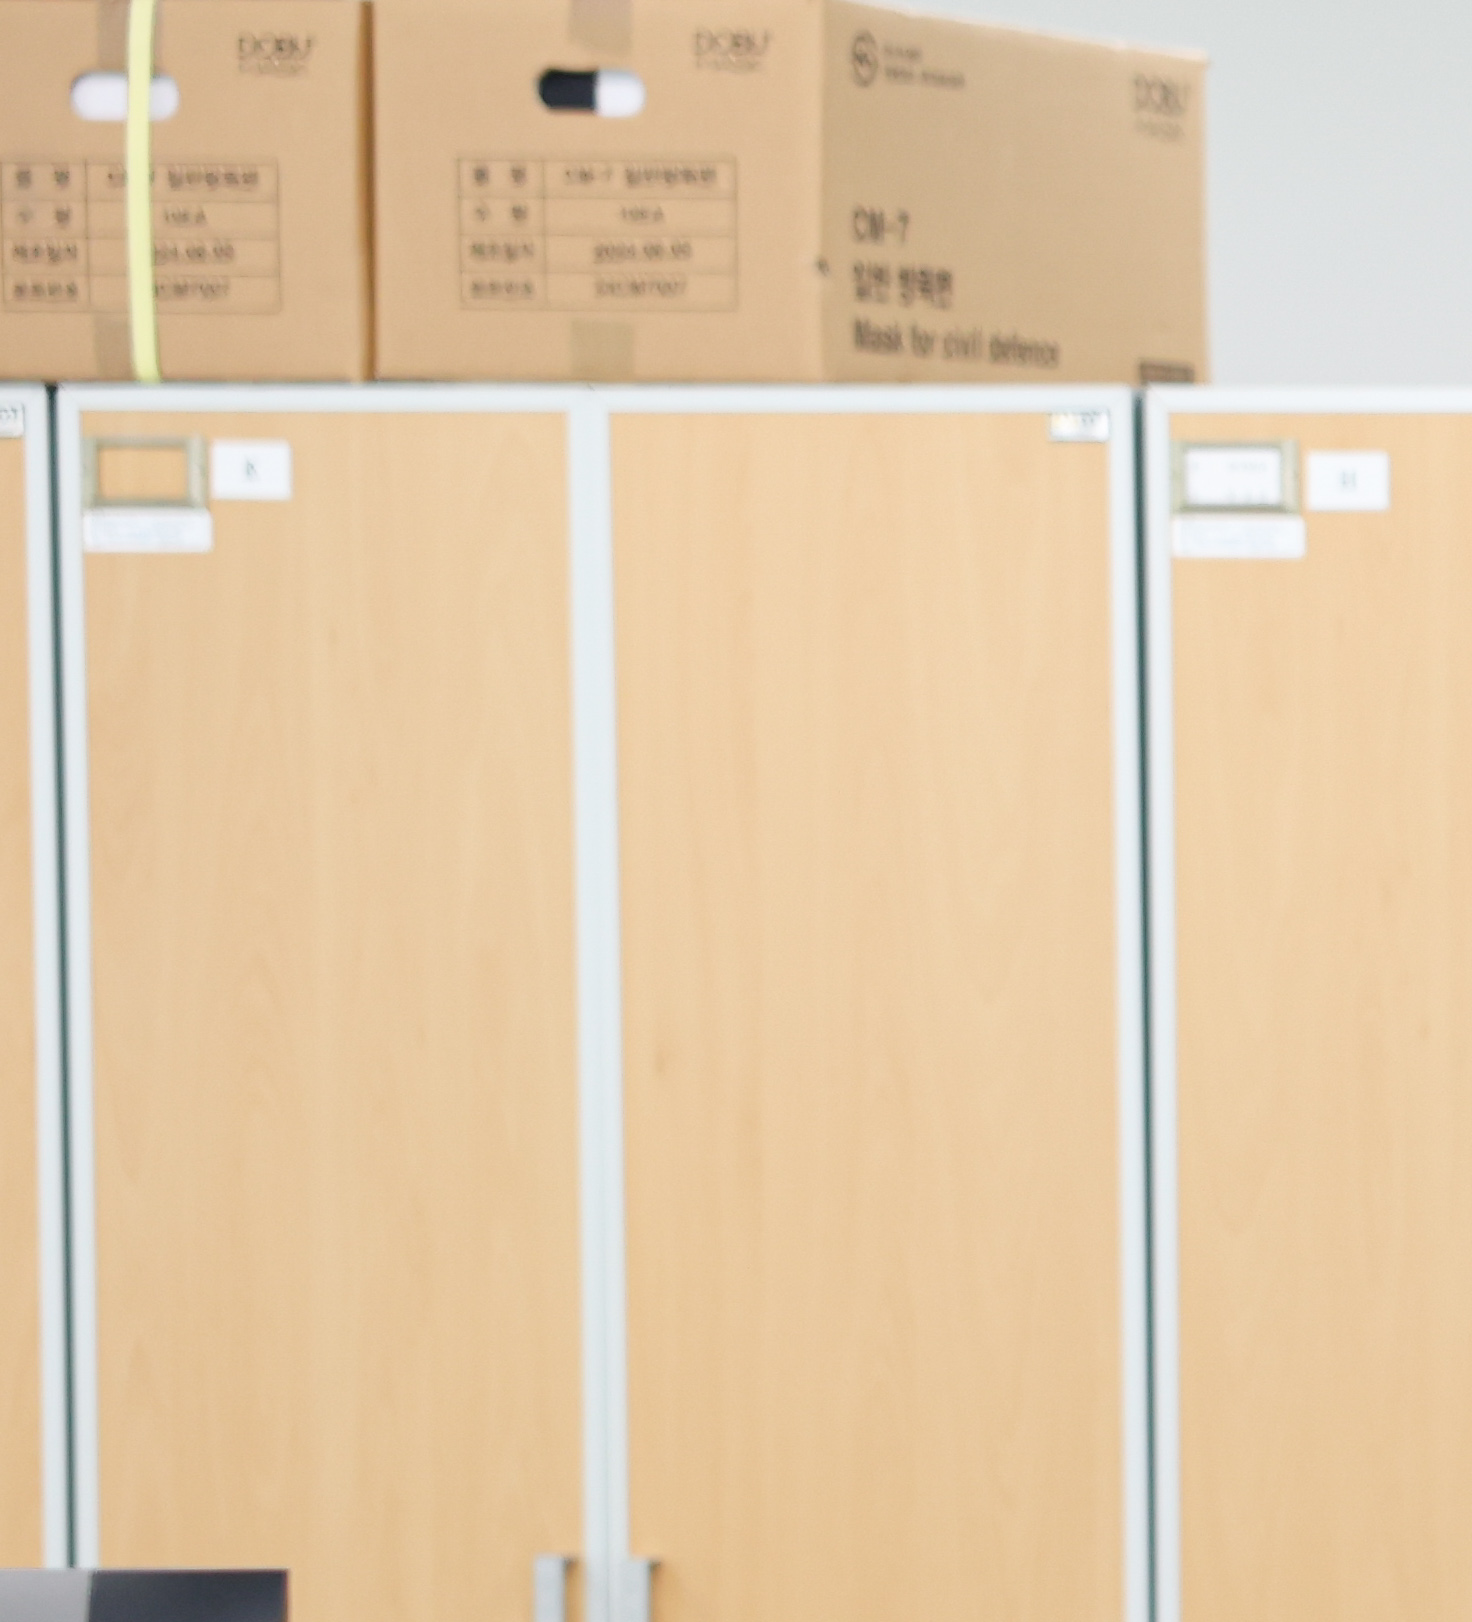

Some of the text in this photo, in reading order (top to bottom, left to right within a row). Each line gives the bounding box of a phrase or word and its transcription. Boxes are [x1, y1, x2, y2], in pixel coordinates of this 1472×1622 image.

[853, 317, 904, 356] Mask
[911, 319, 936, 358] for
[942, 323, 984, 362] civil
